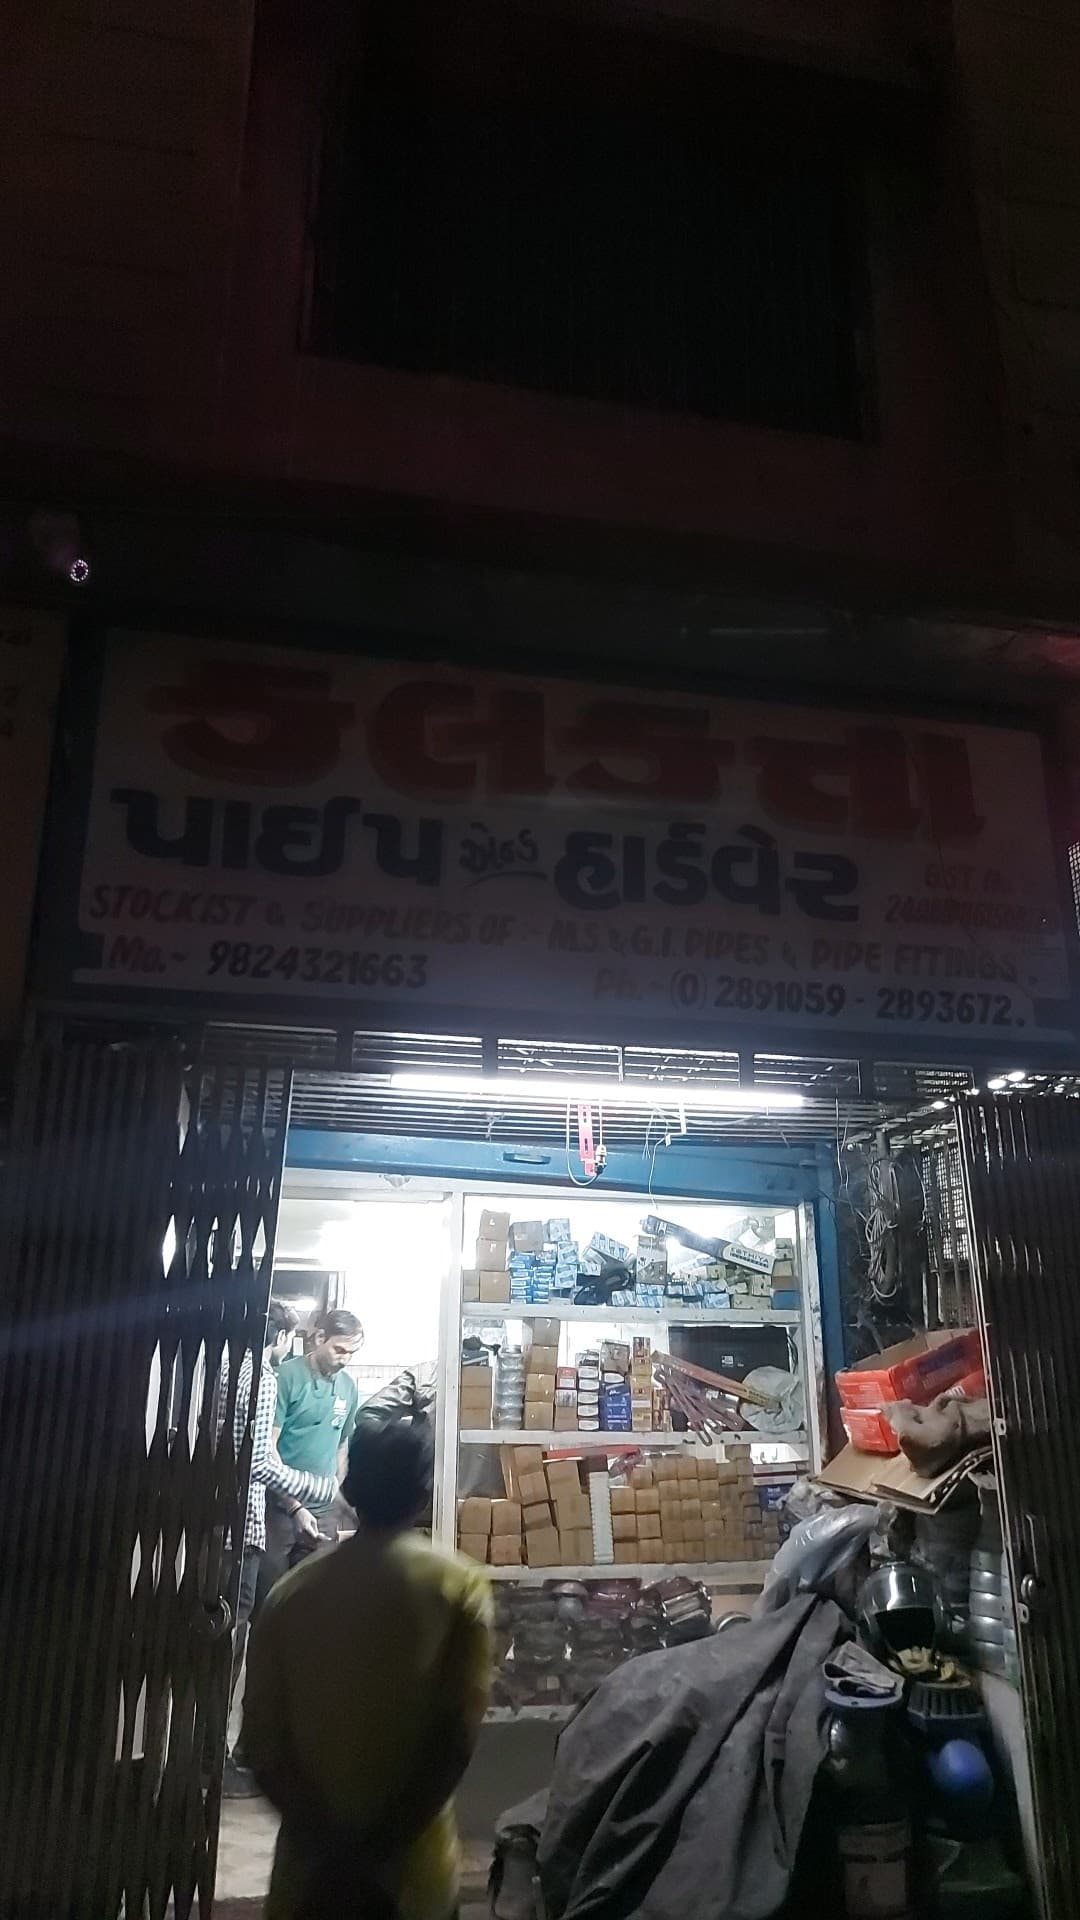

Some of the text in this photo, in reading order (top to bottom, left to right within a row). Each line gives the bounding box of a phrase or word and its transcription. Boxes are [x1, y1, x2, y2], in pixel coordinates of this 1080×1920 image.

[110, 787, 443, 887] પાઈપ
[554, 822, 859, 921] હાર્ડવેર
[89, 884, 258, 926] STOCKIST
[300, 898, 472, 945] SUPPLIERS
[479, 913, 517, 946] OF
[684, 927, 770, 968] PIPES
[810, 938, 882, 973] PIPE
[207, 939, 429, 989] 9824321663
[714, 975, 846, 1017] 2891059
